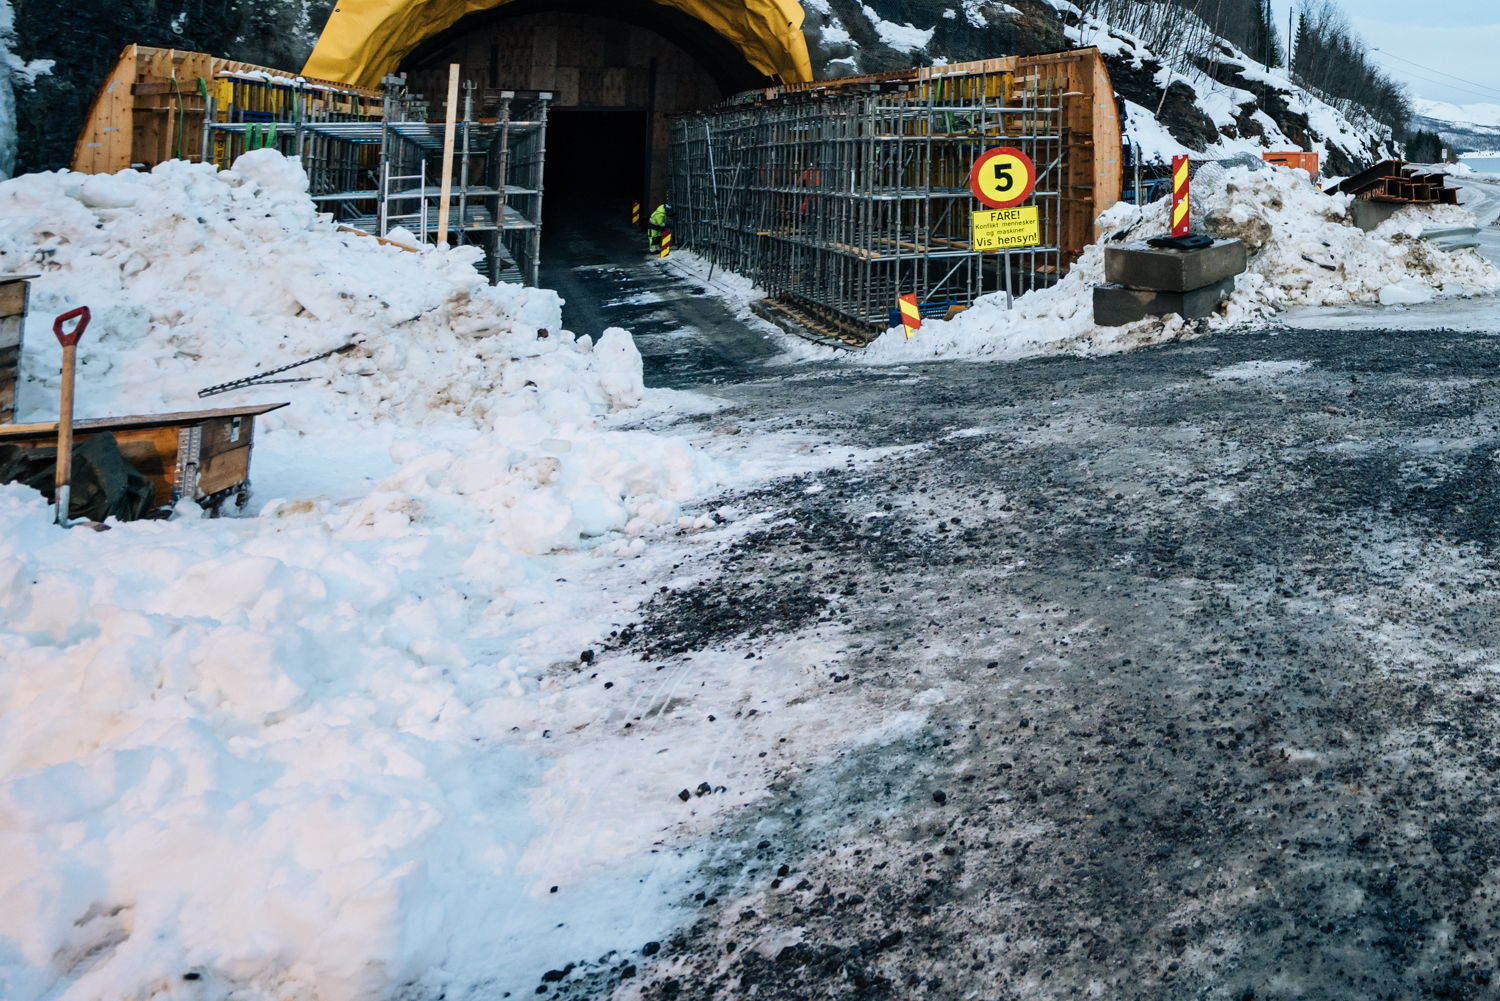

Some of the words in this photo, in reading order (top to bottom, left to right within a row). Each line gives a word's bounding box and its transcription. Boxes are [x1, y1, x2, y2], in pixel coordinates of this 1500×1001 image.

[994, 163, 1013, 192] 5
[990, 211, 1020, 221] FARE!
[975, 222, 999, 230] Konflikt
[1002, 219, 1035, 227] mennesker
[976, 238, 992, 247] Vis
[998, 232, 1037, 245] hensyn!
